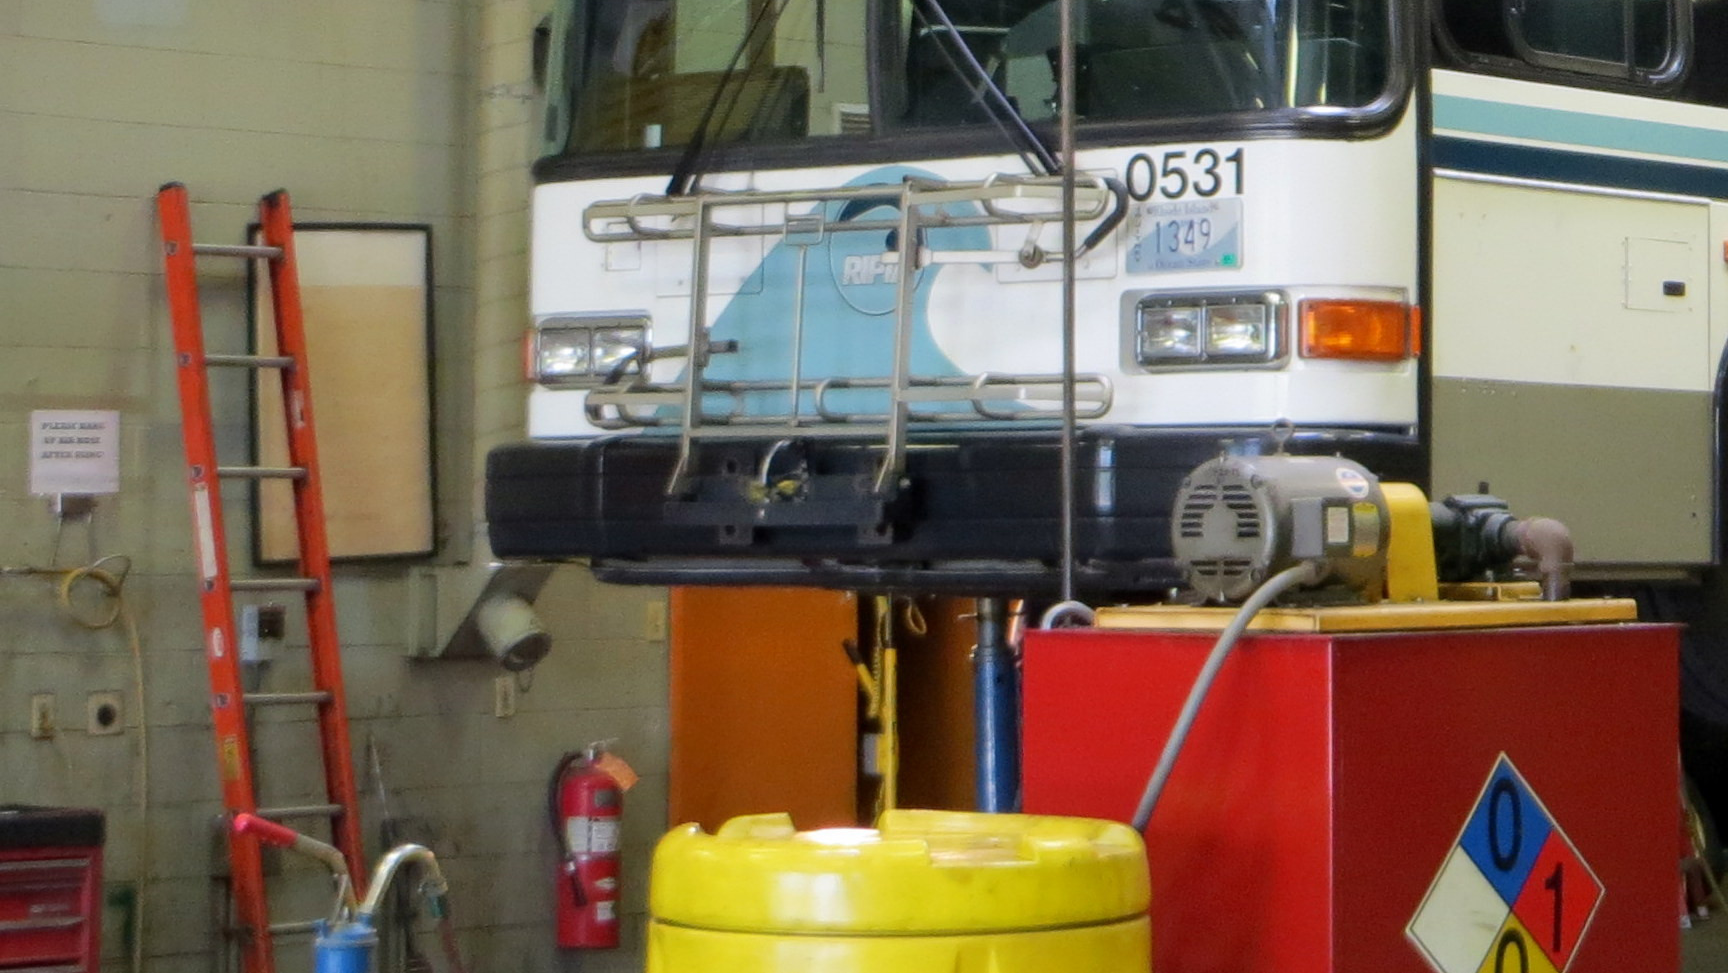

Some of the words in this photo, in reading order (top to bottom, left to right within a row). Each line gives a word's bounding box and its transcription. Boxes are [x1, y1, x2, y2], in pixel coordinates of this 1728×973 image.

[1126, 147, 1244, 202] 0531
[1155, 218, 1211, 254] 1349
[1488, 778, 1522, 872] 0
[1544, 862, 1563, 953] 1
